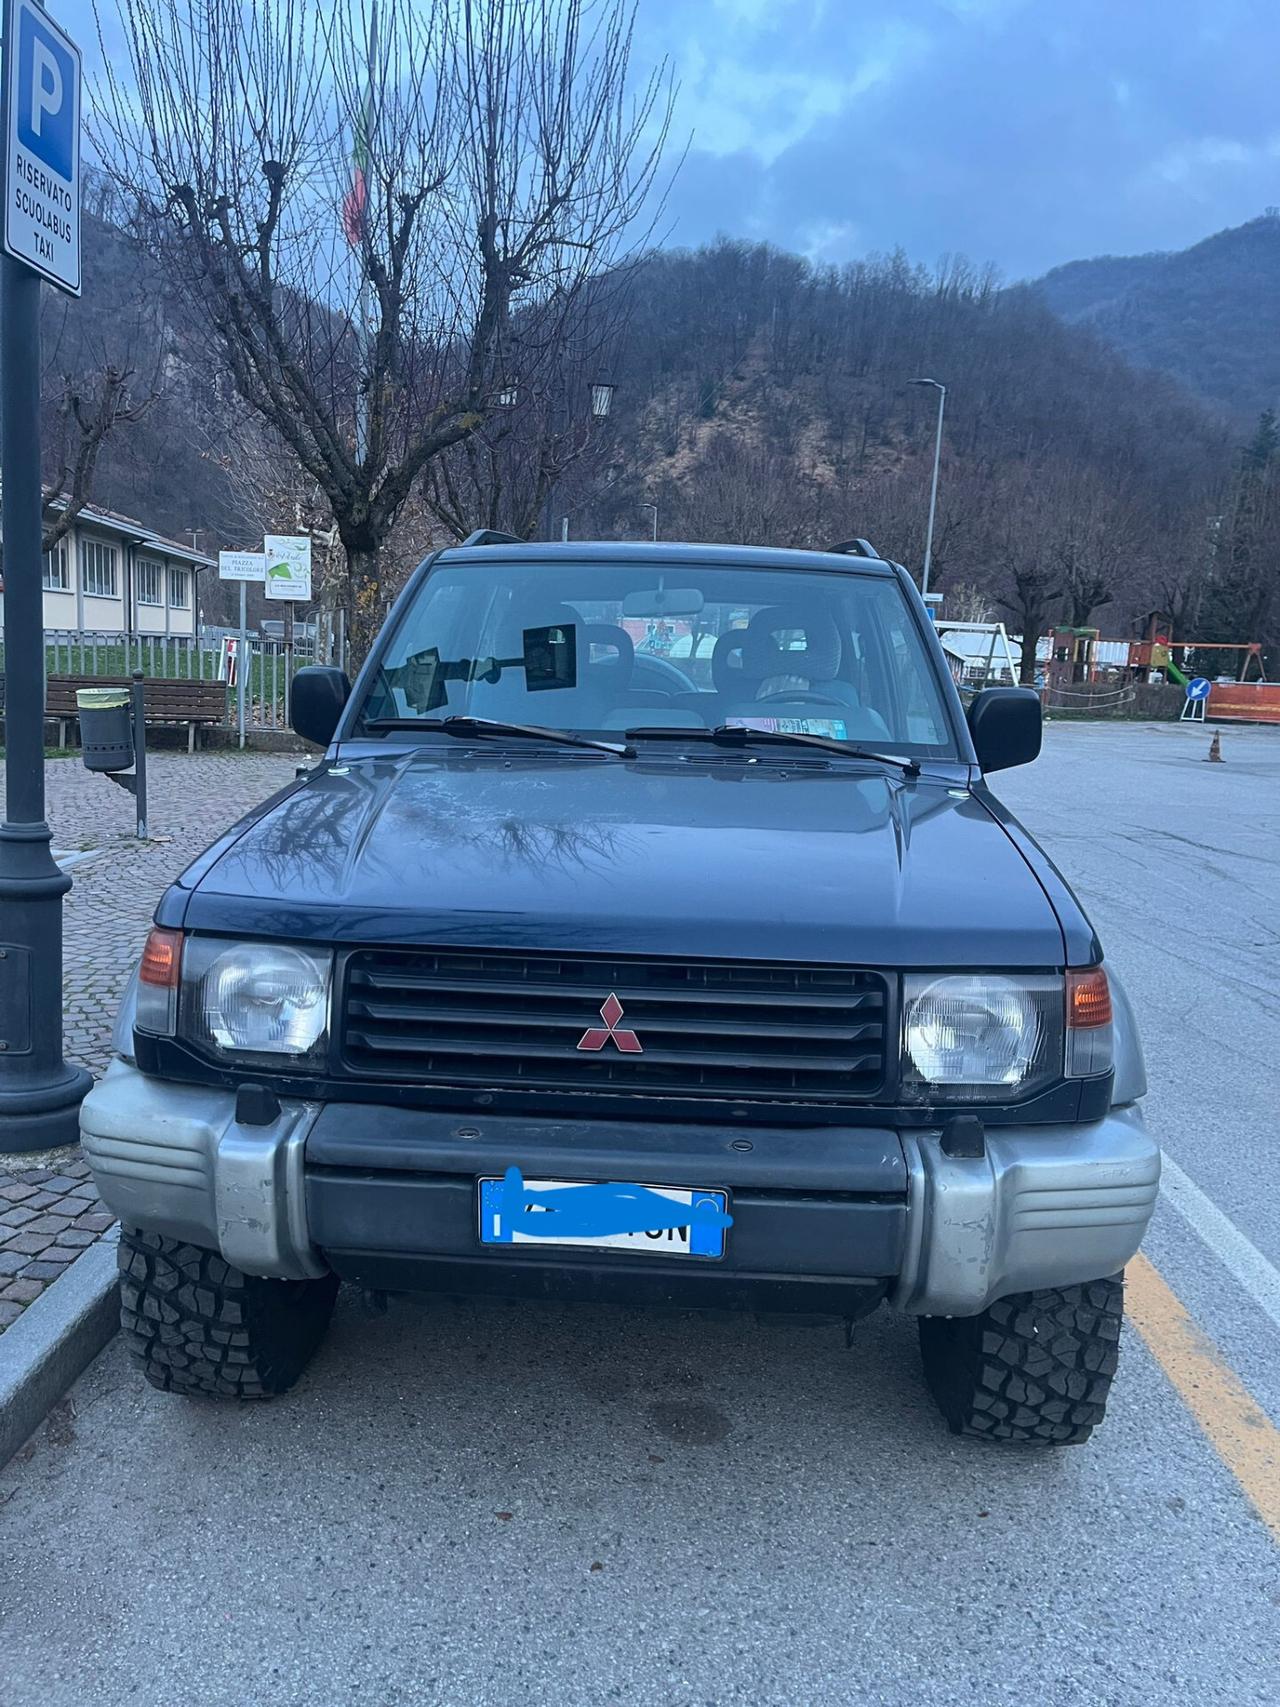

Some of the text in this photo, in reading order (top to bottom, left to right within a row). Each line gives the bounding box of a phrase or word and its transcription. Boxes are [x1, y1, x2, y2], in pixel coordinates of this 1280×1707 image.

[32, 36, 63, 137] P
[16, 153, 72, 212] RISERVATO
[15, 187, 72, 244] SCUOLABUS
[33, 231, 54, 262] TAXI
